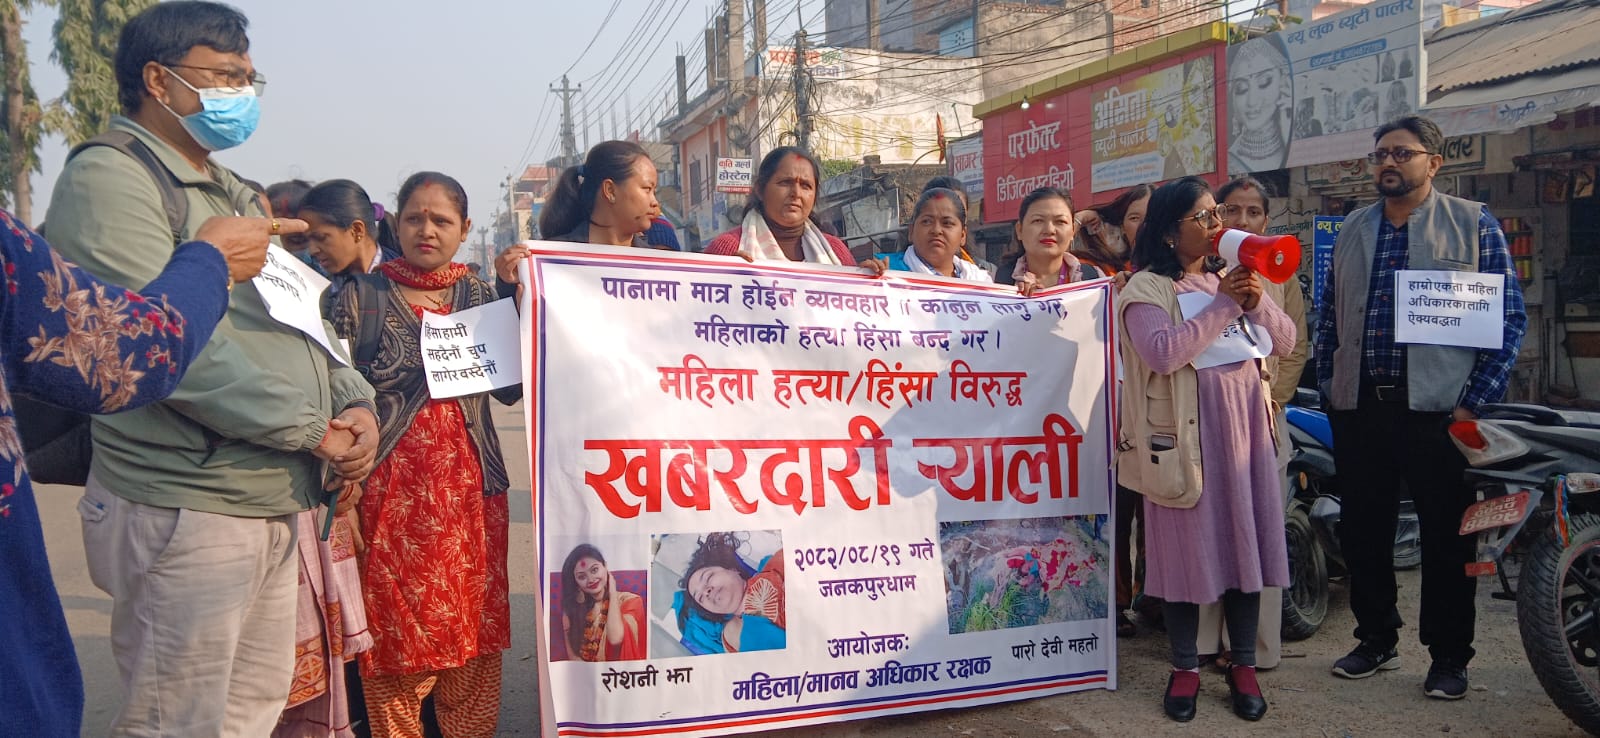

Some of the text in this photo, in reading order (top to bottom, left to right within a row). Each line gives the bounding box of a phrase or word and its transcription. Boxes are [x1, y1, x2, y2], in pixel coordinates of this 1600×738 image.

[1008, 120, 1061, 158] परफेक्ट
[719, 170, 751, 181] होस्टेल
[601, 277, 680, 301] पानामा
[690, 282, 732, 304] मात्र
[742, 279, 796, 310] होईन
[919, 299, 982, 320] कानुन
[1467, 282, 1498, 295] महिला
[694, 314, 789, 346] महिलाको
[799, 326, 846, 349] हत्या
[854, 322, 902, 351] हिंसा
[910, 330, 952, 351] बन्द
[466, 343, 487, 359] चुप
[656, 354, 759, 408] महिला
[949, 359, 1027, 408] विरुद्ध
[584, 415, 893, 519] खबरदारी
[795, 538, 934, 571] २०८२/०८/१९ गते
[818, 575, 917, 600] जनकपुरधाम
[1011, 633, 1098, 661] पारो देवी महतो
[602, 665, 659, 692] रोशनी
[866, 659, 941, 686] अधिकार
[946, 656, 992, 680] रक्षक
